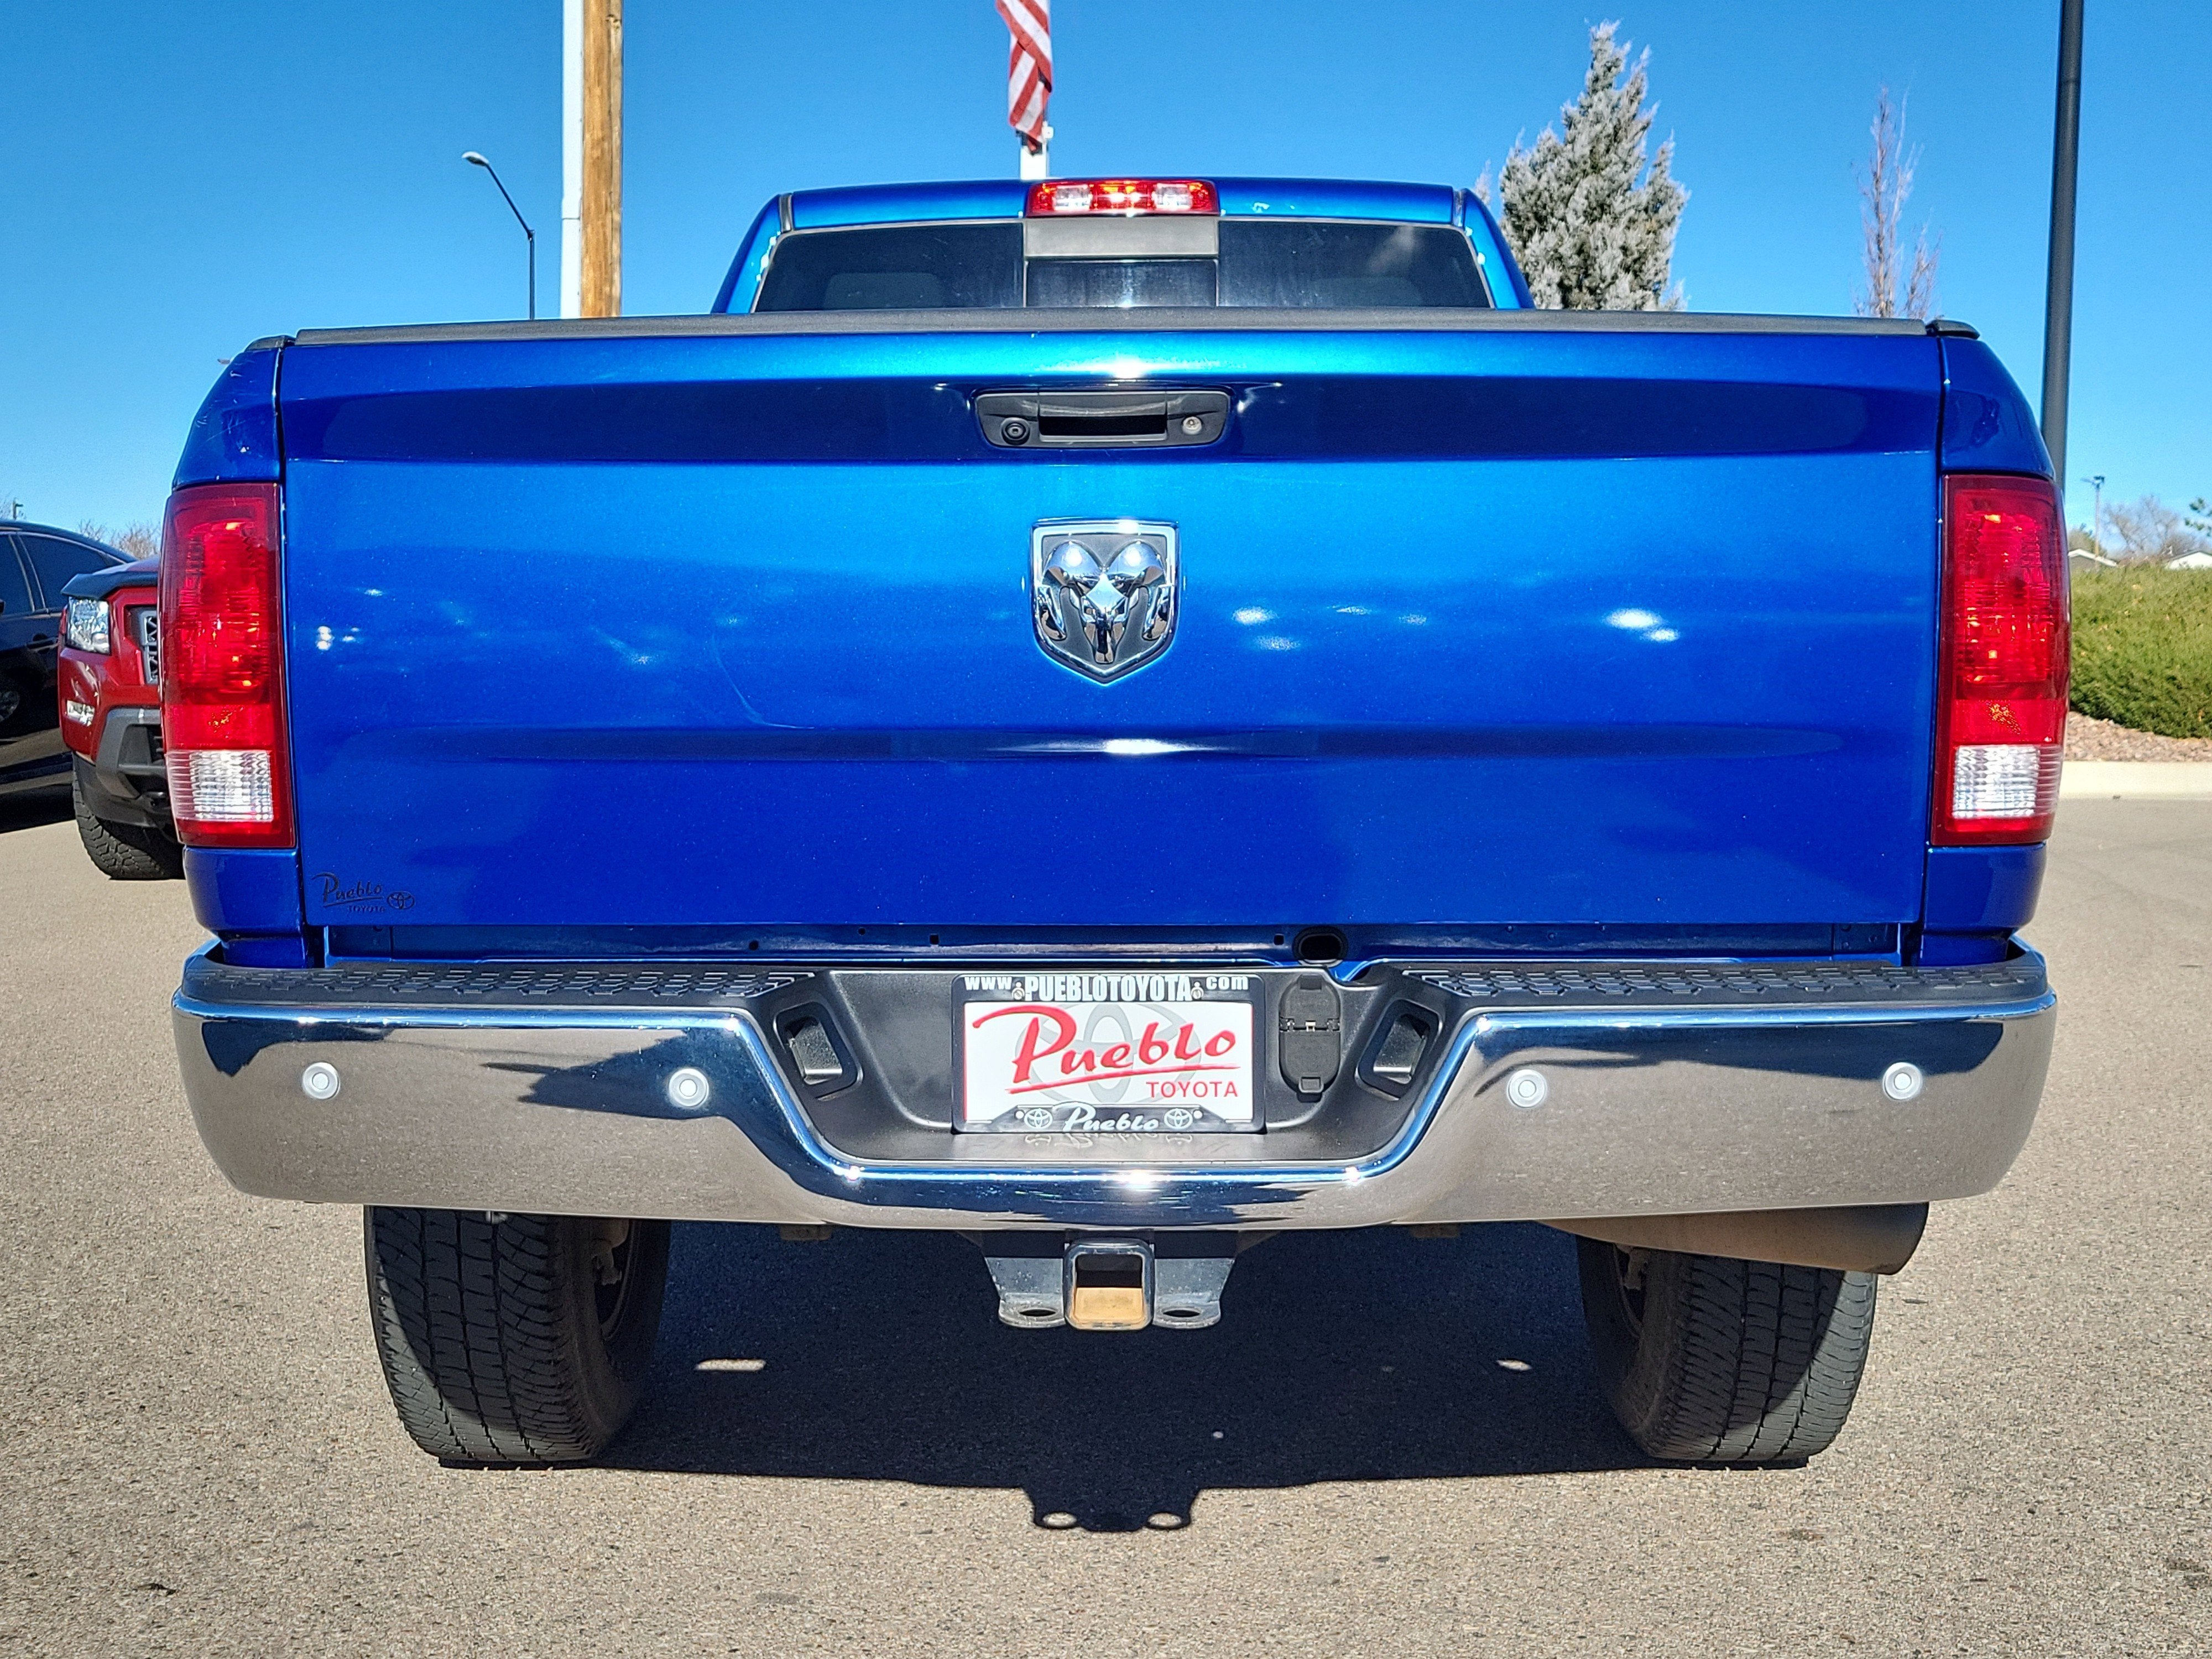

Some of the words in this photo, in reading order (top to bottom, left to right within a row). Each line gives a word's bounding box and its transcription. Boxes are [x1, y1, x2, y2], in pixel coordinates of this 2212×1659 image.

[311, 872, 383, 902] Pueblo
[1024, 975, 1193, 1002] PUEBLOTOYOTA
[972, 1005, 1237, 1084] Pueblo
[1146, 1081, 1239, 1098] TOYOTA
[1052, 1101, 1160, 1132] Pueblo
